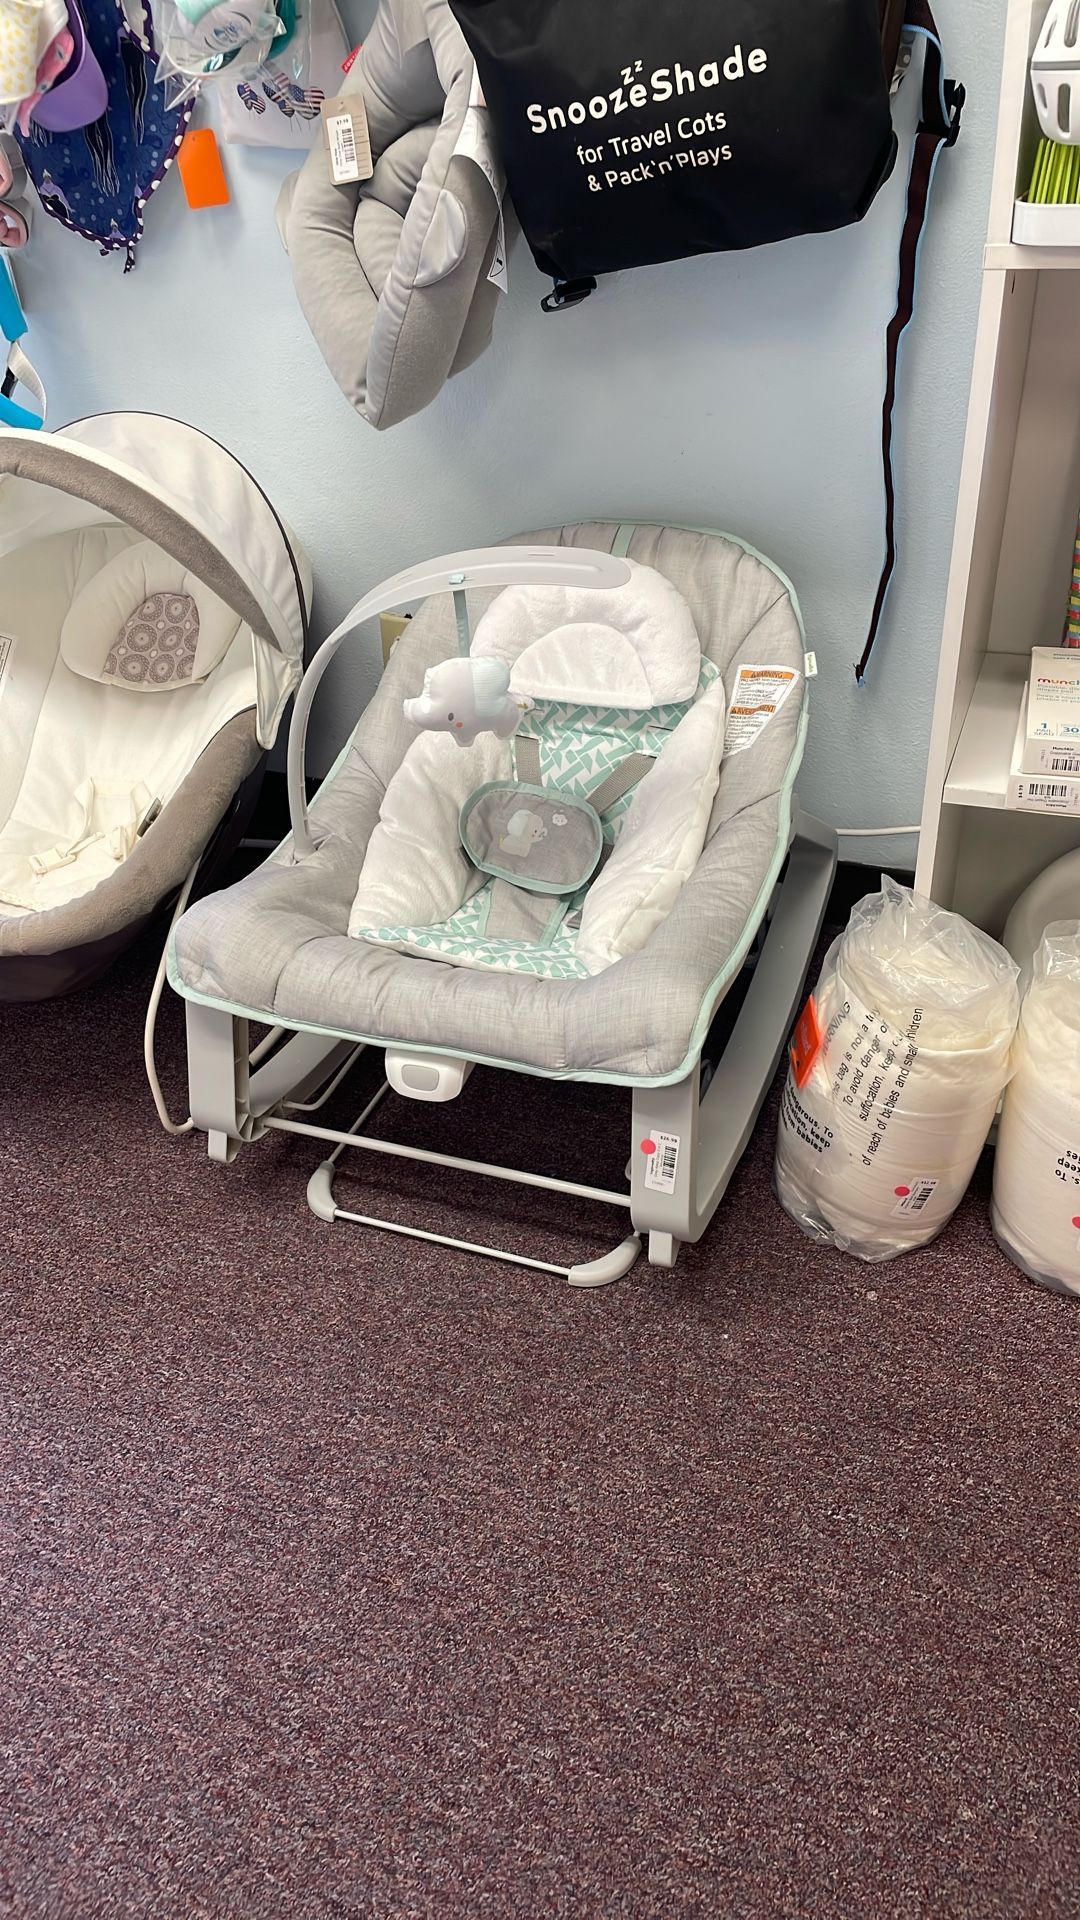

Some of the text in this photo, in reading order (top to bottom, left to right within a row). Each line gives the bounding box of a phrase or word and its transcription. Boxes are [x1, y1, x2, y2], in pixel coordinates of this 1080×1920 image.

[576, 111, 727, 165] for Travel Cots
[587, 175, 602, 192] &
[835, 1062, 849, 1080] bag
[844, 1051, 853, 1062] is
[850, 1033, 865, 1051] not
[861, 1024, 869, 1033] a
[843, 1095, 854, 1106] To
[849, 1067, 864, 1094] avoid
[860, 1034, 881, 1068] danger
[895, 1066, 910, 1088] and
[859, 1076, 886, 1121] suffocation,
[878, 1048, 896, 1071] keep
[879, 1090, 900, 1119] babies
[824, 1126, 834, 1138] To
[876, 1118, 887, 1130] of
[796, 1126, 823, 1153] babies
[811, 1127, 831, 1148] keep
[867, 1132, 883, 1155] reach
[862, 1154, 872, 1166] of
[1055, 1169, 1067, 1182] To
